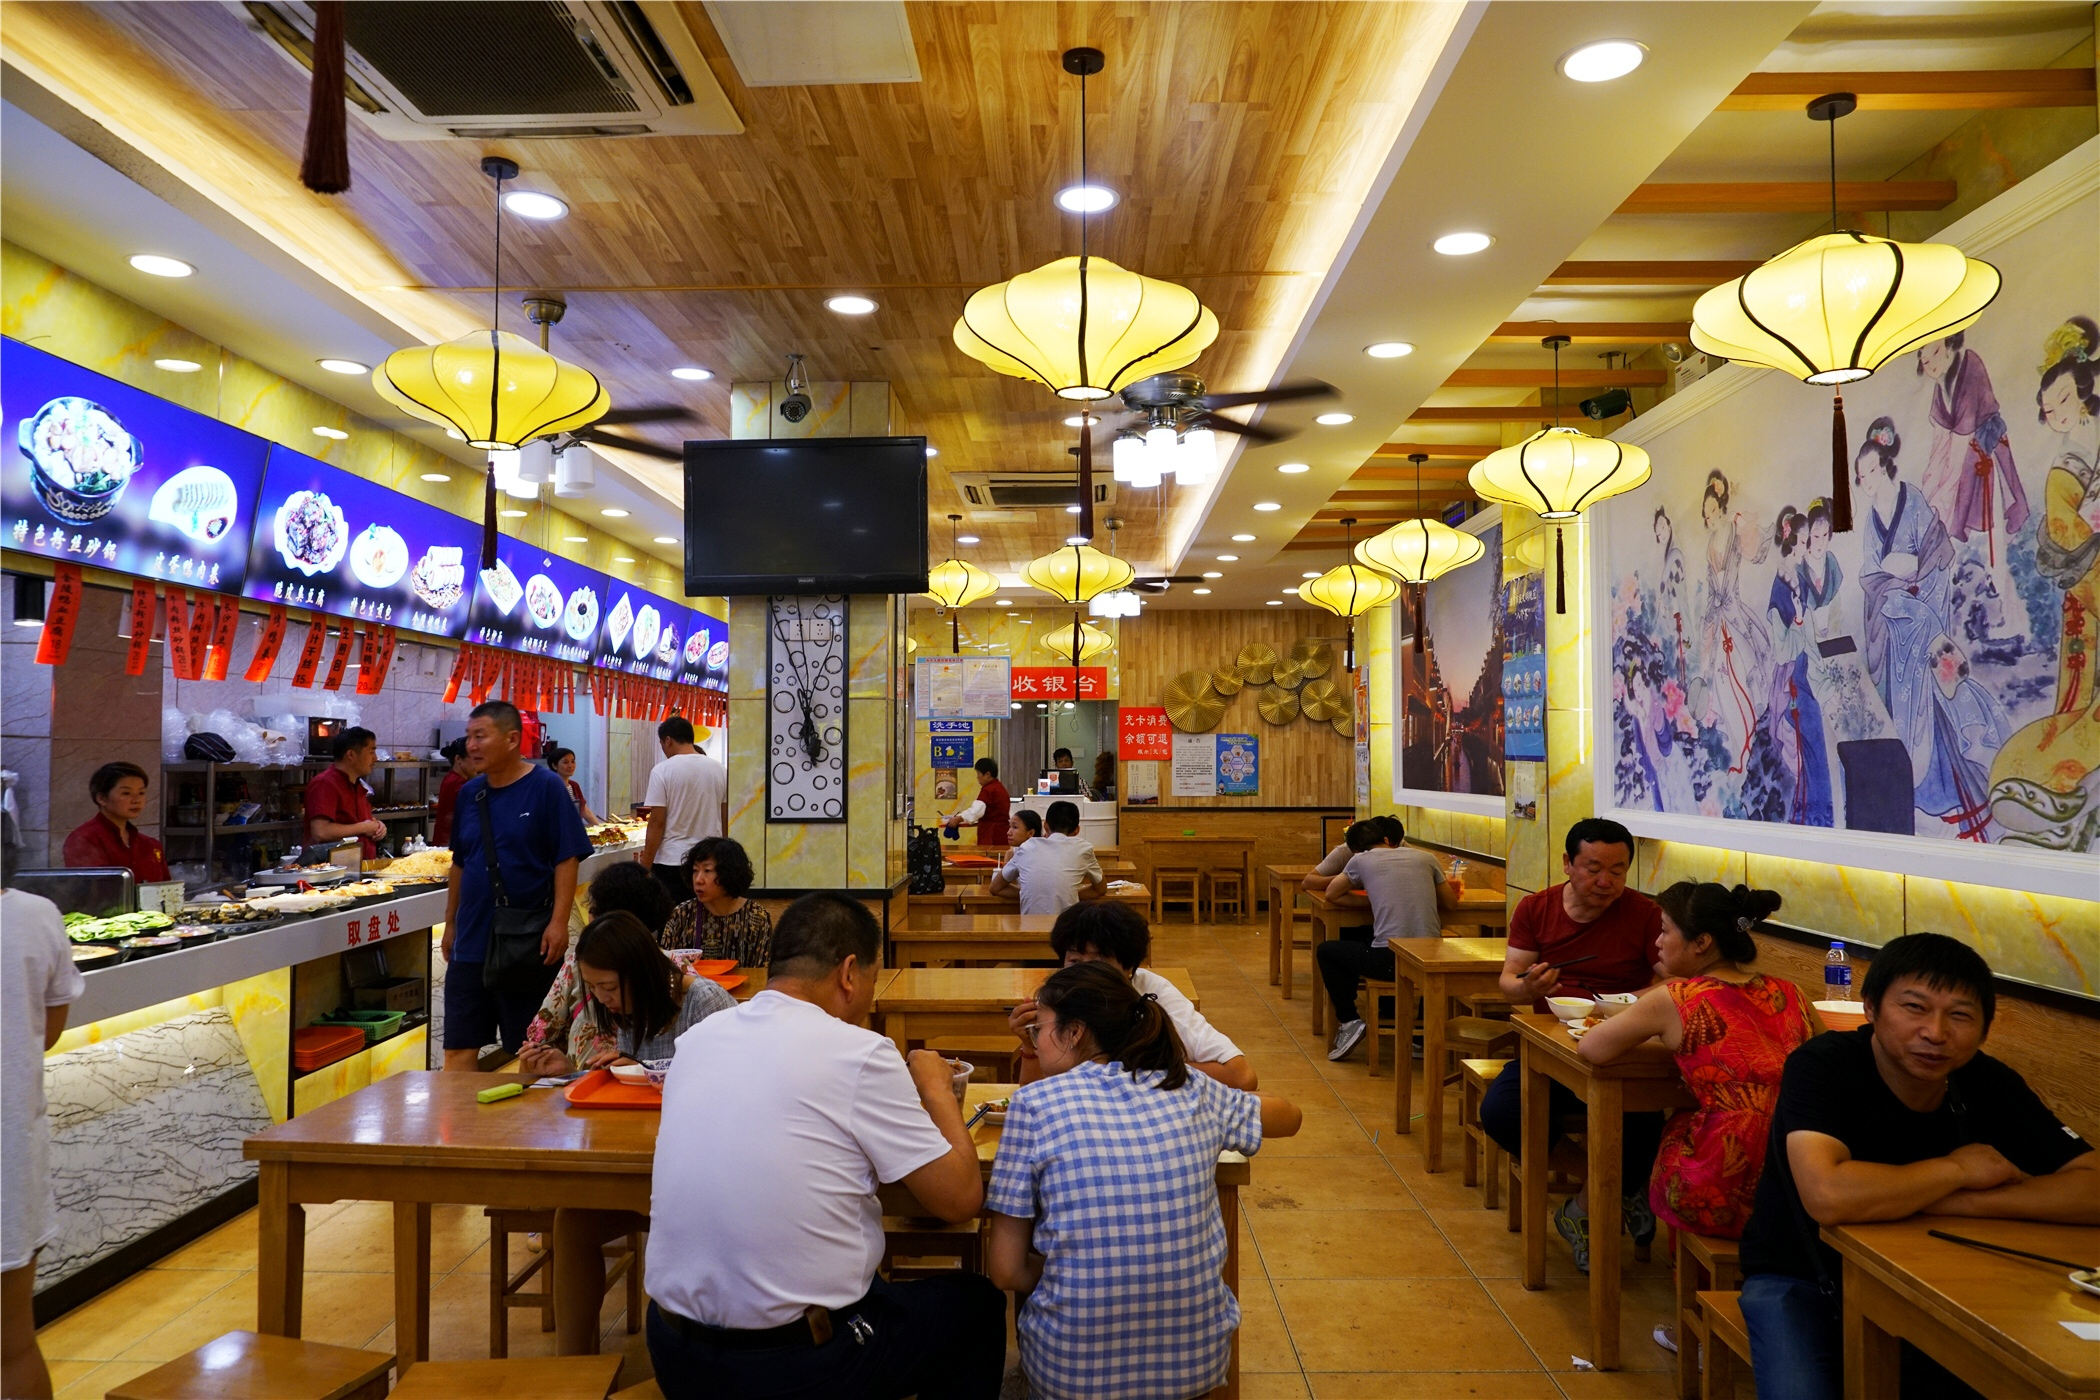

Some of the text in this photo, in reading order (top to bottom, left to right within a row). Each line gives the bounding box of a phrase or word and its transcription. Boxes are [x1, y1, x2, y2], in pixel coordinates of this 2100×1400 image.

[13, 519, 117, 562] 特色粉丝砂锅
[273, 580, 325, 608] 脆皮臭豆腐
[295, 621, 323, 684] 鸡汁干丝 15
[332, 627, 350, 672] 生煎包
[1012, 675, 1097, 693] 收银台
[932, 721, 971, 729] 洗手池
[1125, 715, 1168, 726] 充卡消费
[1124, 733, 1168, 745] 余额可退
[347, 910, 400, 946] 取盘处
